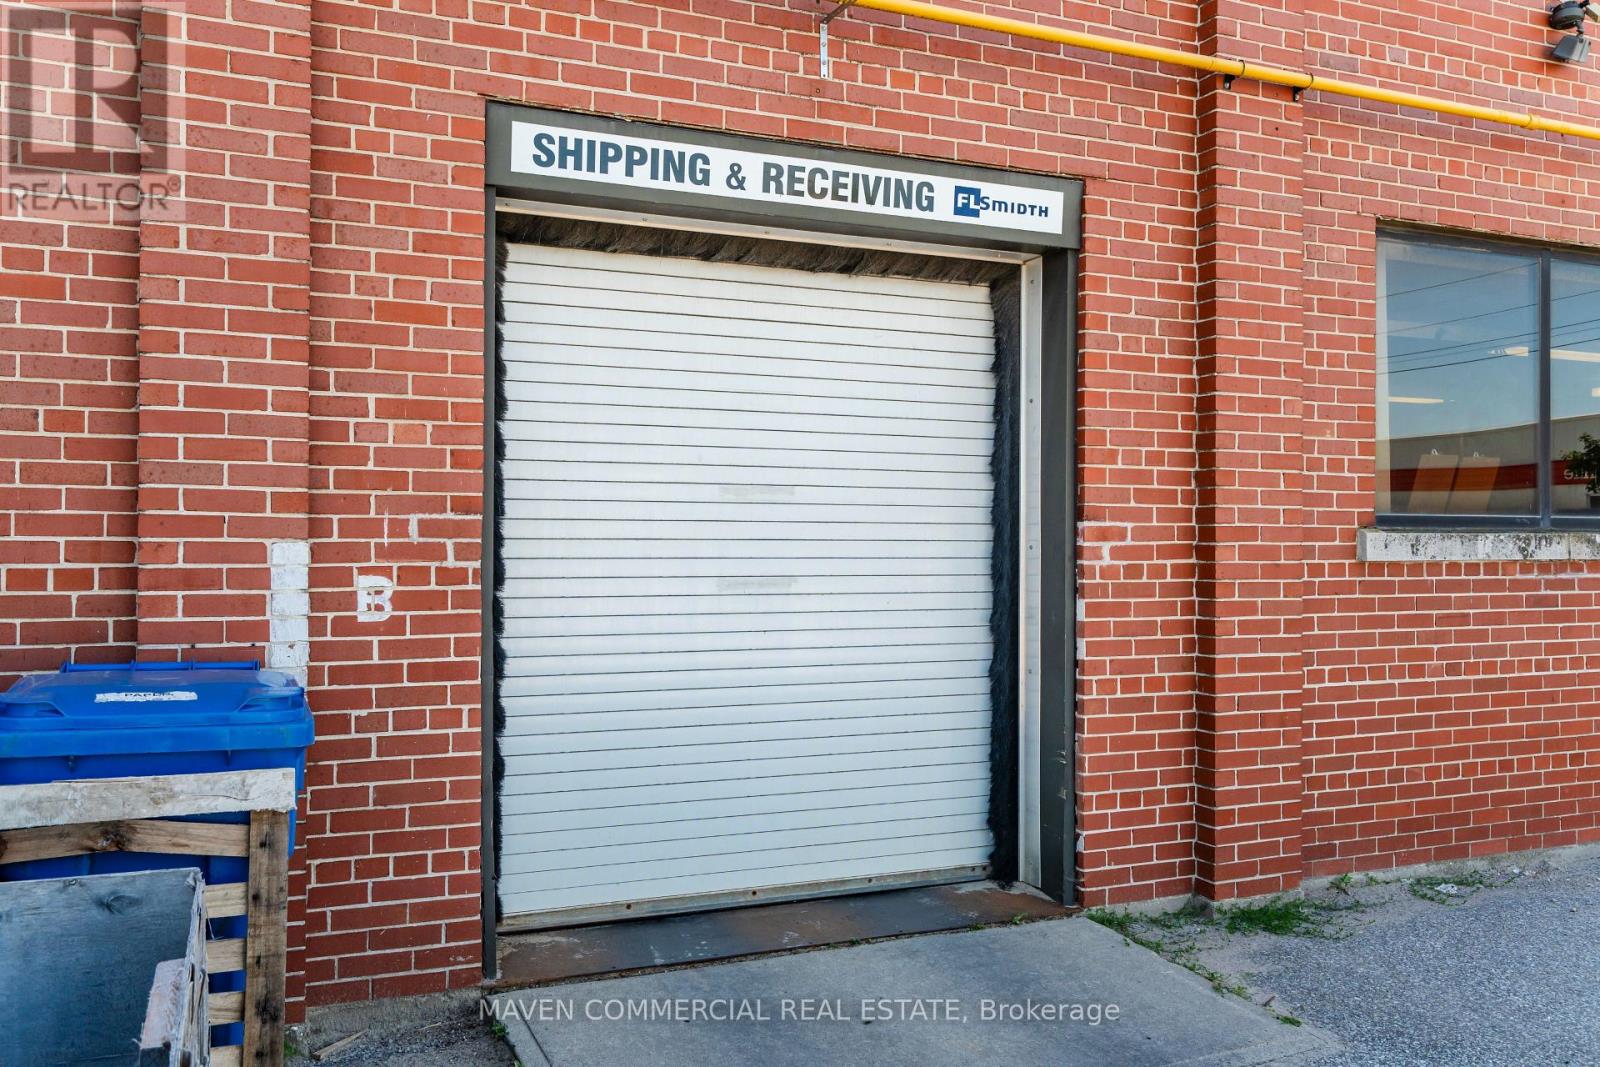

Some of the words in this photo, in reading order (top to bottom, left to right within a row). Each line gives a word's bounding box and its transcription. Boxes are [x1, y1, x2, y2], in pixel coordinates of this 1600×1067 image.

[532, 132, 711, 187] SHIPPING
[725, 162, 747, 191] &
[762, 161, 935, 213] RECEIVING
